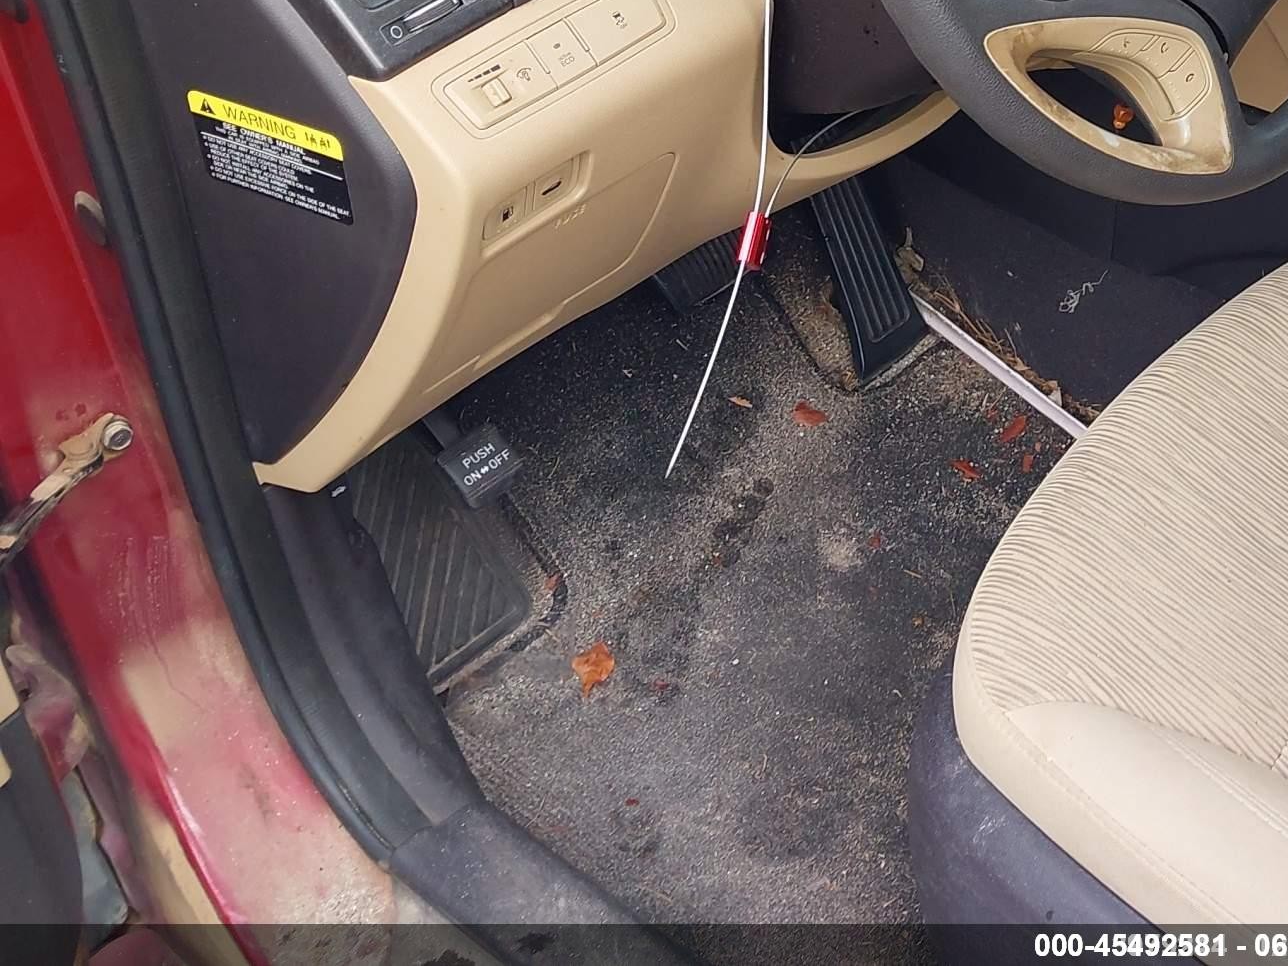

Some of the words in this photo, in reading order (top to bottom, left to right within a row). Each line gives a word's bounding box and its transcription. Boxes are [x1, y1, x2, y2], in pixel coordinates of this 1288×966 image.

[222, 104, 296, 138] WARNING
[462, 442, 496, 469] PUSH
[464, 470, 482, 486] ON
[488, 448, 510, 470] OFF
